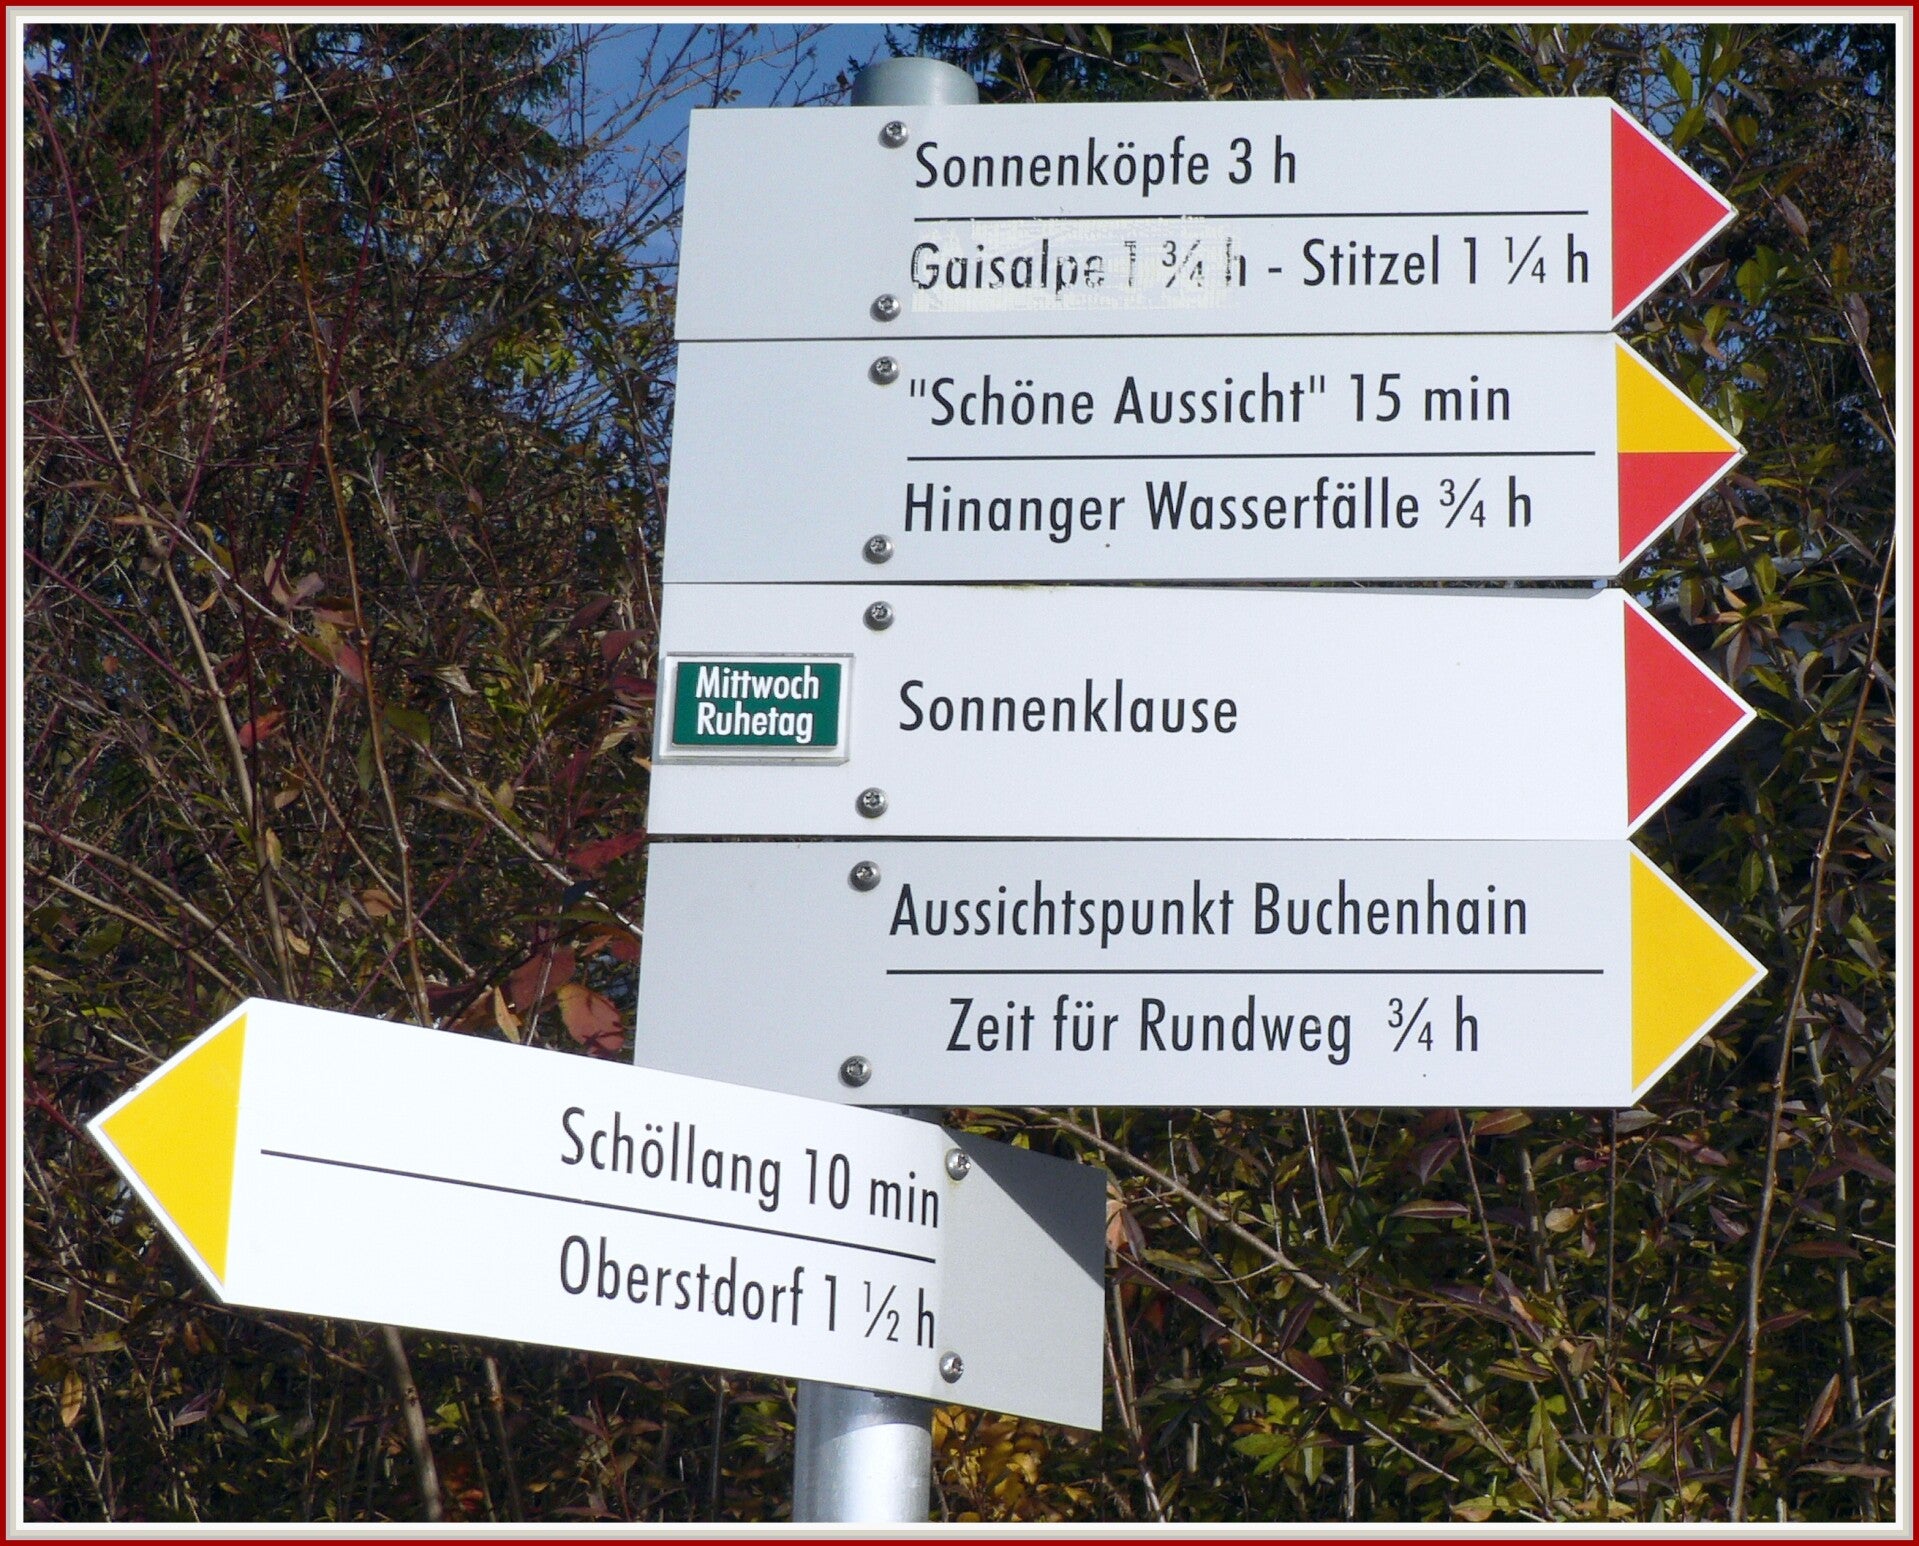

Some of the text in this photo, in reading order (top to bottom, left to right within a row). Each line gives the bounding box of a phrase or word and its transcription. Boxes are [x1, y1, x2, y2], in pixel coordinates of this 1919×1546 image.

[915, 134, 1296, 198] Sonnenköpfe 3 h
[910, 238, 1105, 301] Gaisalpe
[1225, 236, 1247, 288] h
[1303, 234, 1439, 287] Stitzel
[1463, 237, 1476, 284] 1
[1567, 233, 1588, 283] h
[910, 371, 1510, 426] "Schöne Aussicht" 15 min
[904, 483, 1126, 544] Hinanger
[1145, 476, 1419, 530] Wasserfälle
[1508, 475, 1531, 528] h
[695, 664, 820, 700] Mittwoch
[899, 678, 1238, 734] Sonnenklause
[696, 701, 814, 744] Ruhetag
[889, 878, 1528, 949] Aussichtspunkt Buchenhain
[946, 997, 1036, 1053] Zeit
[1053, 994, 1120, 1053] für
[1138, 994, 1352, 1066] Rundweg
[1454, 994, 1480, 1053] h
[560, 1106, 940, 1229] Schöllang 10 min
[559, 1234, 805, 1327] Oberstdorf
[824, 1274, 838, 1332] 1
[916, 1286, 936, 1350] h
